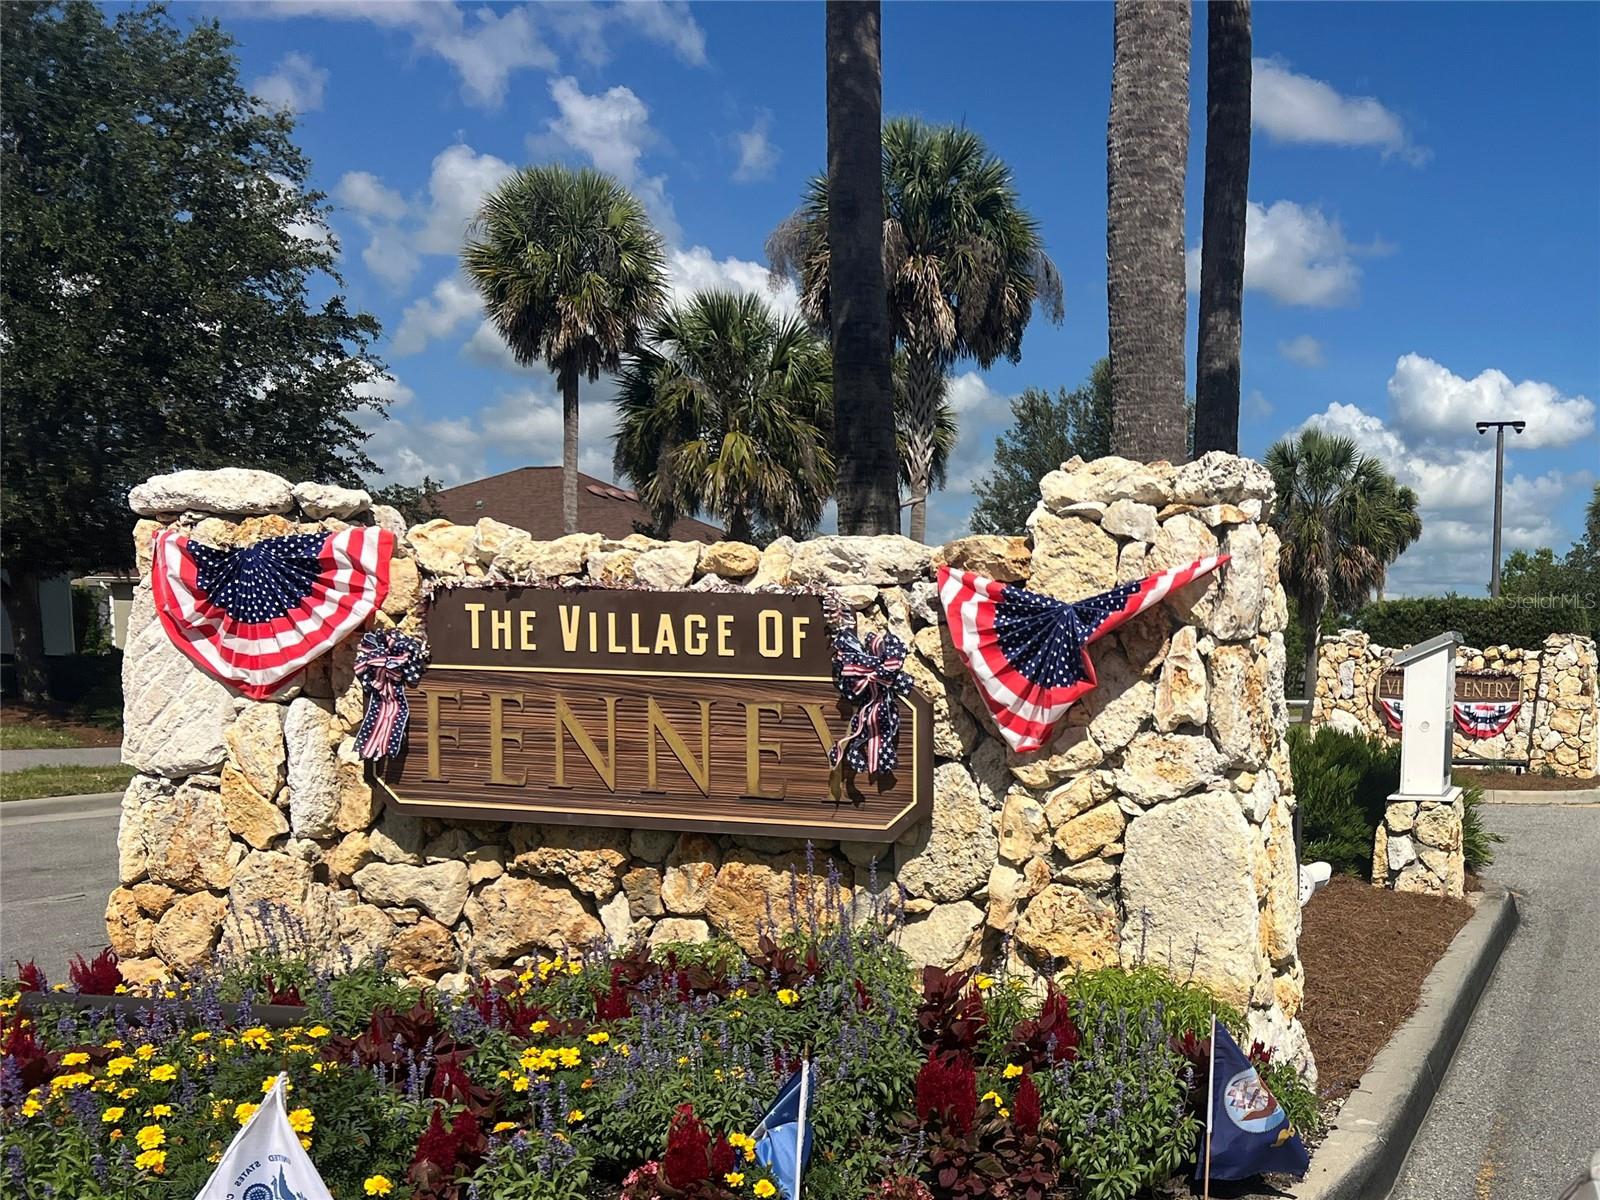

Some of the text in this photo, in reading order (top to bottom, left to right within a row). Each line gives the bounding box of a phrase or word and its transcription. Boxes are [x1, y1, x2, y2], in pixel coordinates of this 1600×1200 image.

[464, 603, 810, 658] THE VILLAGE OF
[1463, 681, 1515, 700] ENTRY
[419, 689, 862, 803] FENNEY
